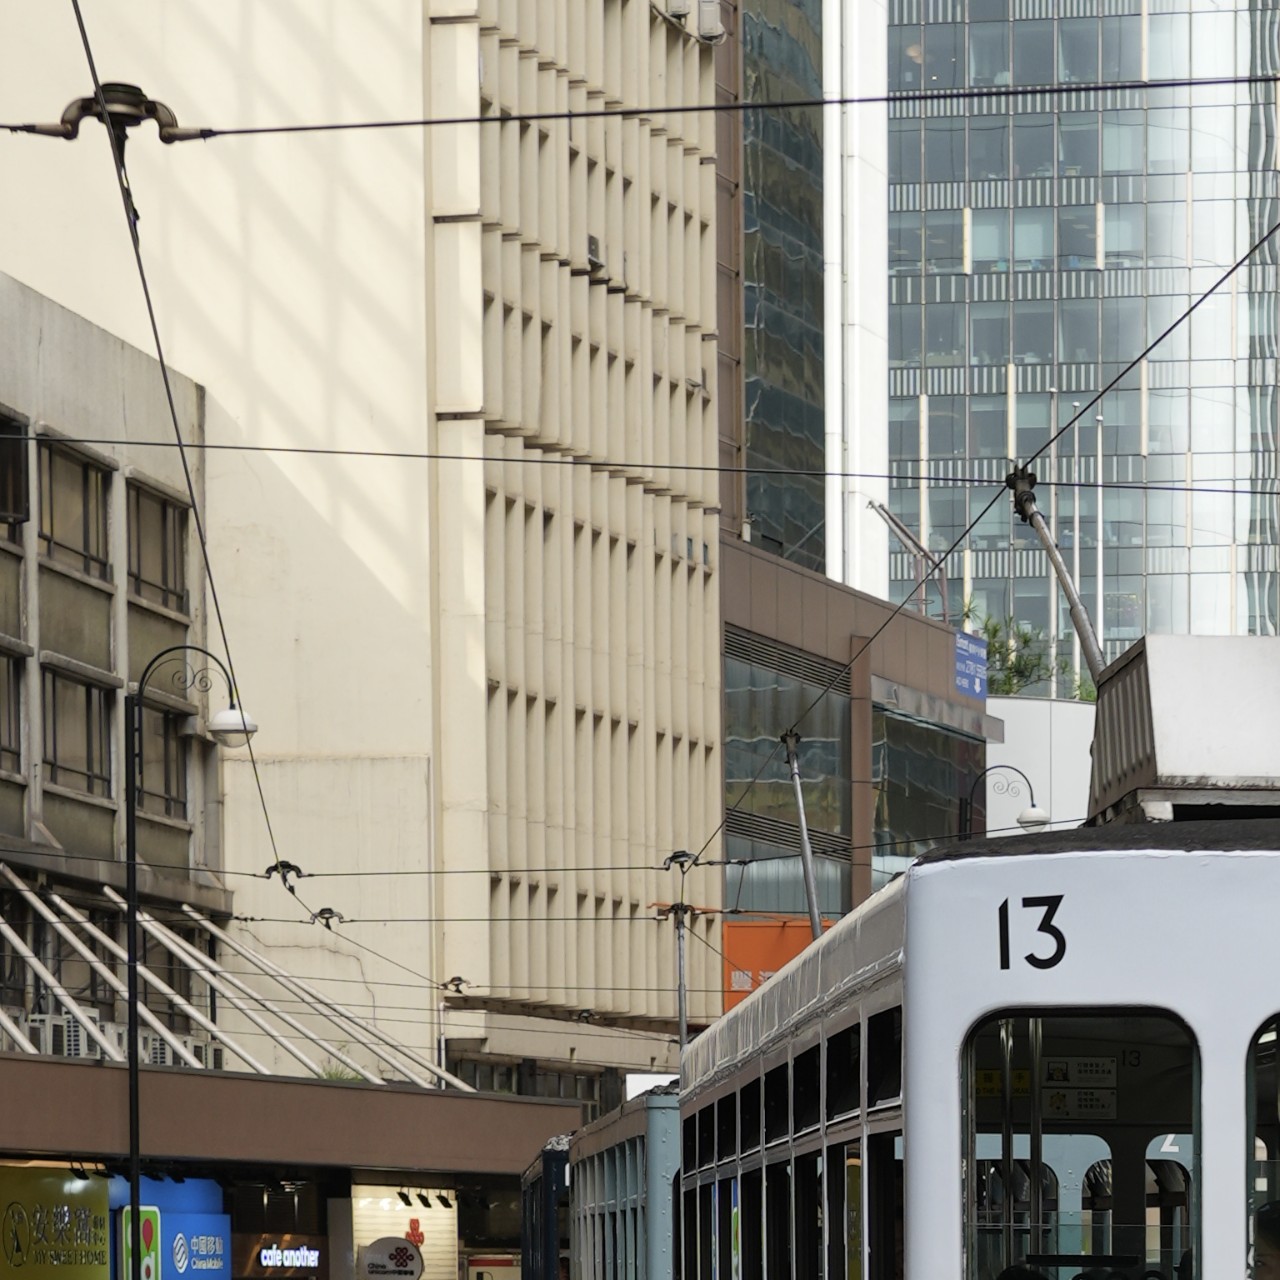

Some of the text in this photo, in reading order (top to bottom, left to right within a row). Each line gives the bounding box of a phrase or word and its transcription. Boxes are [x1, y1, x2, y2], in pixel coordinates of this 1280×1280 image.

[998, 895, 1067, 971] 13
[79, 1249, 107, 1265] HOME
[260, 1244, 319, 1267] cafe another
